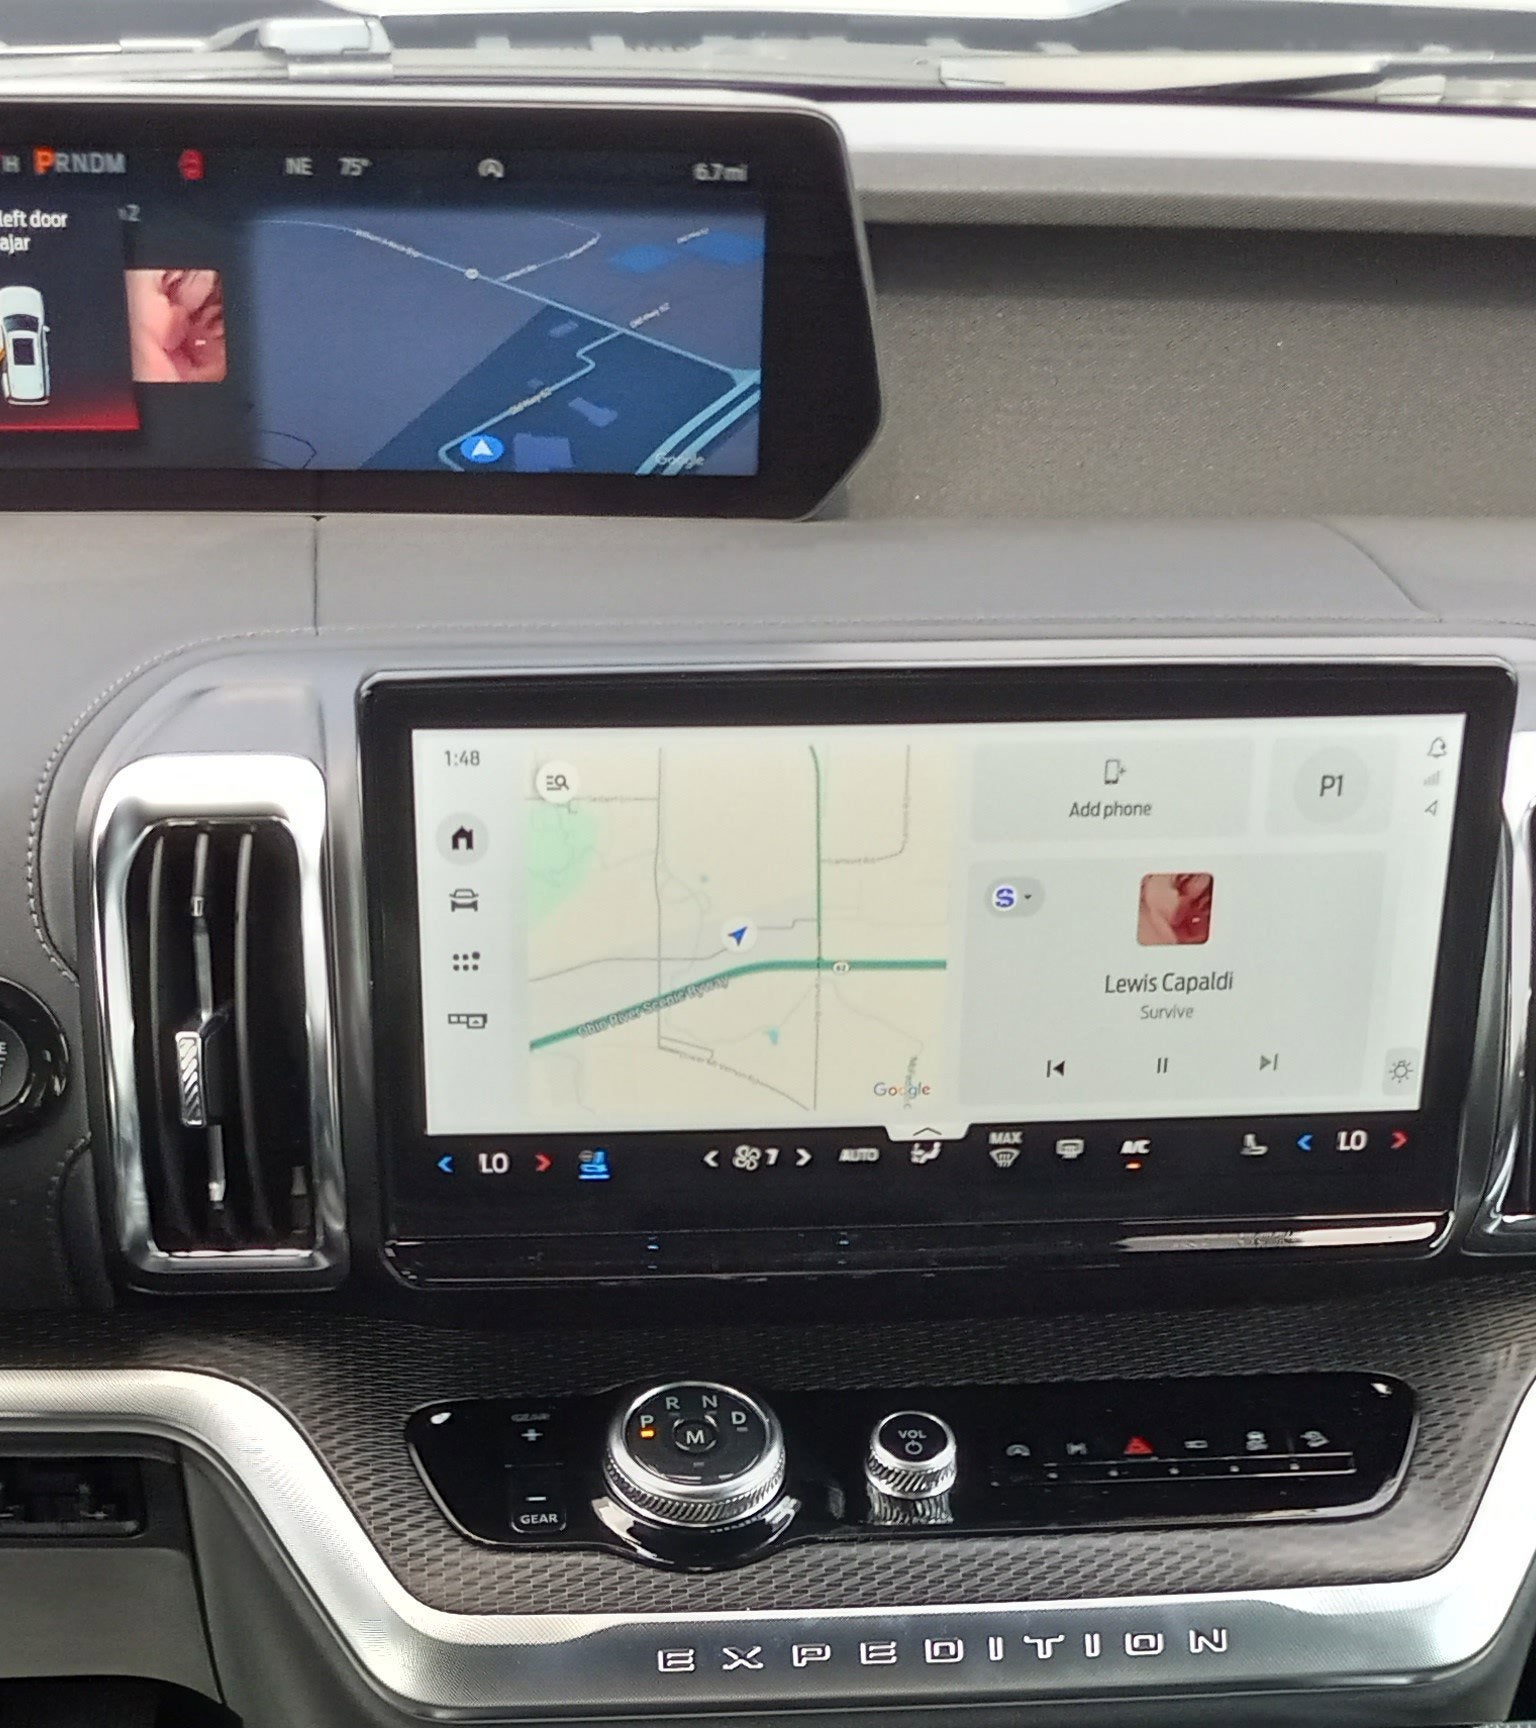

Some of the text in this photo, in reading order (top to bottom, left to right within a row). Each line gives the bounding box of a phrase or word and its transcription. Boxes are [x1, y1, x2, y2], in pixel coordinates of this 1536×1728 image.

[285, 156, 313, 176] NE
[28, 209, 68, 228] door
[444, 750, 481, 767] 1:48
[1068, 801, 1153, 820] Add phone
[1104, 970, 1234, 995] Lewis Capaldi
[1140, 1004, 1194, 1020] Survive
[873, 1081, 931, 1099] Google
[989, 1131, 1023, 1145] MAX
[1335, 1130, 1368, 1152] LO
[839, 1148, 881, 1163] AUTO
[1120, 1139, 1151, 1156] A/C
[478, 1152, 510, 1174] LO
[666, 1396, 681, 1411] R
[702, 1395, 719, 1409] N
[640, 1414, 655, 1428] P
[732, 1411, 747, 1426] D
[686, 1429, 705, 1445] M
[897, 1429, 927, 1440] VOL
[519, 1513, 559, 1525] GEAR
[657, 1627, 1229, 1674] EXPEDITION
